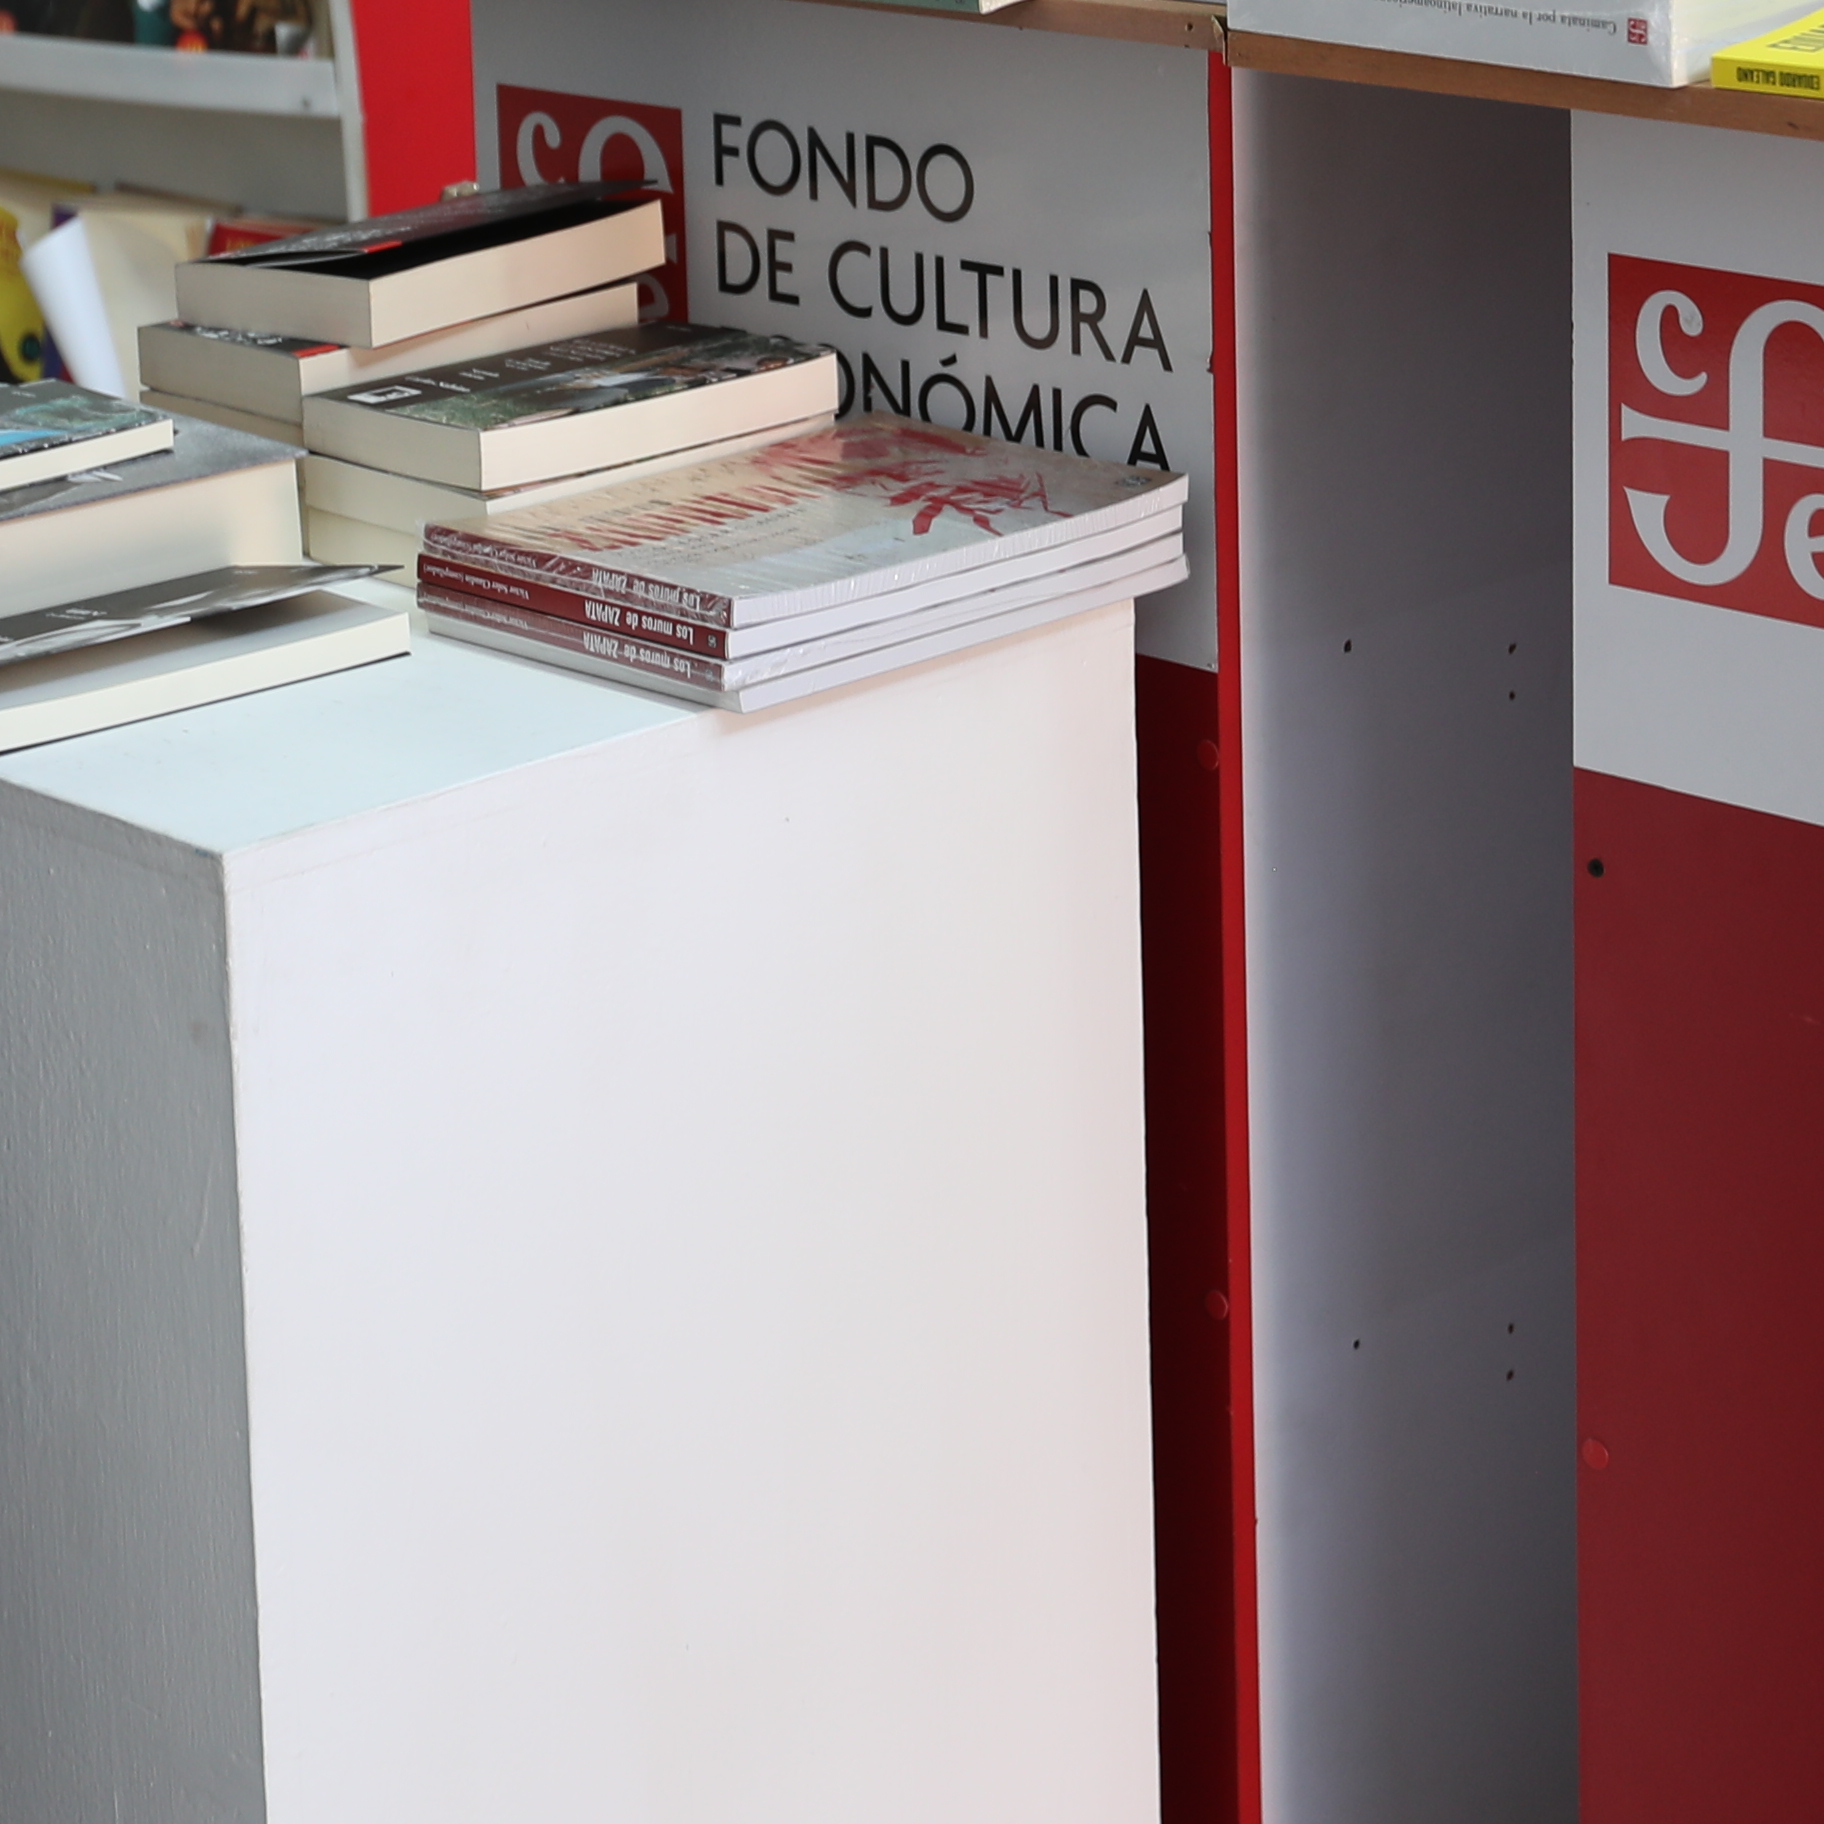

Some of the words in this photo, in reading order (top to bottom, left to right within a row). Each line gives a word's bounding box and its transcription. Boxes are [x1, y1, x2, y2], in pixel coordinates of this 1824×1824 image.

[1464, 3, 1519, 22] narrativa
[1520, 11, 1534, 25] la
[1535, 10, 1557, 26] por
[1559, 13, 1617, 36] Caminata
[1736, 67, 1777, 86] GALEANO
[1779, 72, 1821, 92] EDUARDO
[712, 112, 975, 223] FONDO
[716, 220, 800, 306] DE
[827, 239, 1173, 373] CULTURA
[834, 346, 1172, 471] ONÓMICA
[590, 568, 628, 595] ZAPATA
[632, 578, 645, 598] de
[648, 582, 680, 605] muros
[681, 592, 701, 613] Los
[583, 599, 621, 627] ZAPATA
[625, 610, 639, 632] de
[640, 615, 673, 639] muros
[675, 623, 694, 646] Los
[581, 630, 619, 660] ZAPATA
[623, 642, 637, 663] de
[639, 646, 671, 670] muros
[673, 656, 692, 679] Los
